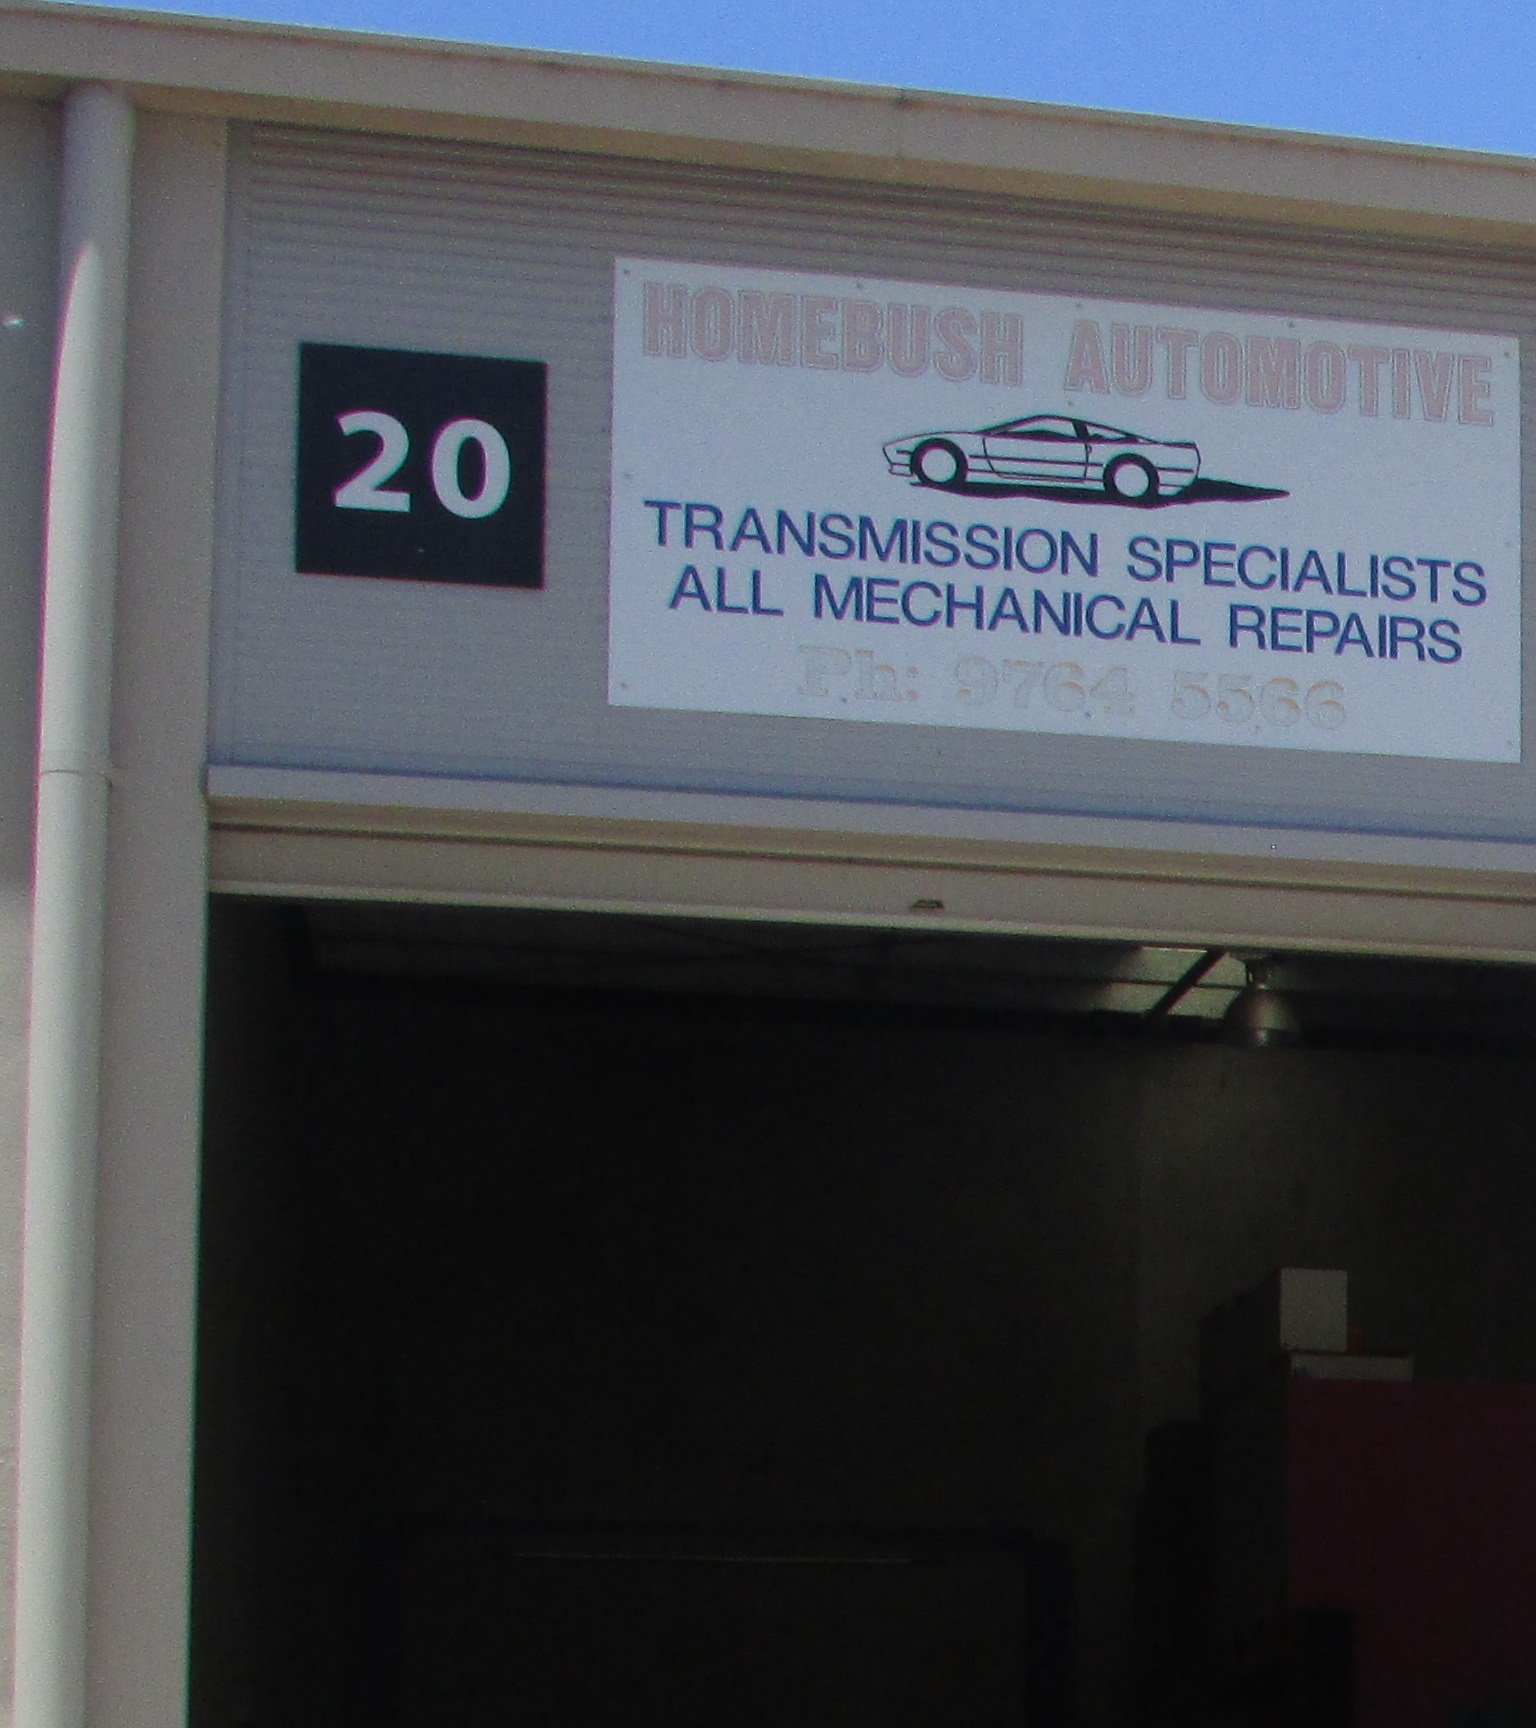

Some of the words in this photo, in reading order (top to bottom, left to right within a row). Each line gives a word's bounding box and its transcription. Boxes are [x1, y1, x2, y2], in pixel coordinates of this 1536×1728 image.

[643, 282, 1024, 387] HOMEBUSH
[1064, 320, 1494, 427] AUTOMOTIVE
[335, 409, 511, 519] 20
[643, 499, 1100, 577] TRANSMISSION
[1126, 535, 1487, 608] SPECIALISTS
[668, 564, 784, 617] ALL
[813, 573, 1201, 646] MECHANICAL
[1228, 603, 1463, 664] REPAIRS
[799, 645, 920, 702] Ph:
[954, 655, 1136, 716] 9764
[1171, 669, 1346, 732] 5566
